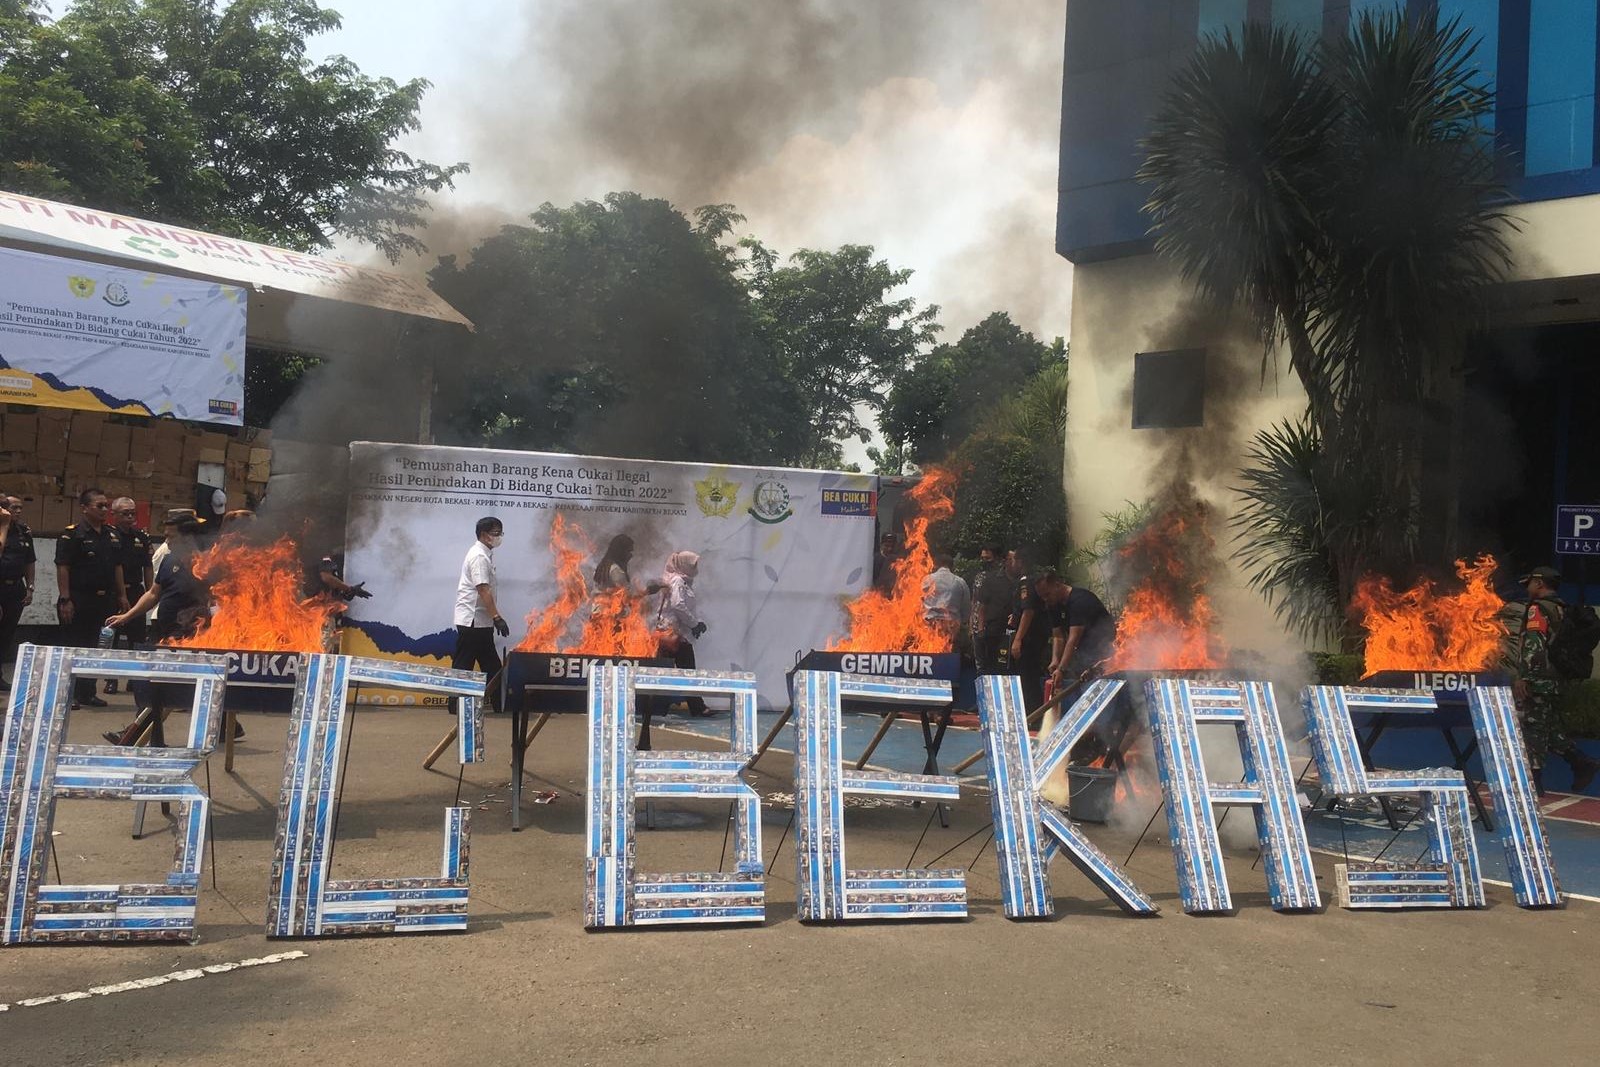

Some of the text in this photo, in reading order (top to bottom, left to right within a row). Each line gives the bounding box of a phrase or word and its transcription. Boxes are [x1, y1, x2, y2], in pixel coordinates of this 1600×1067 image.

[64, 208, 253, 258] MANDIRI
[260, 248, 415, 291] LESTARI
[0, 311, 13, 322] sil
[15, 313, 72, 330] Penindakan
[75, 322, 85, 332] Di
[88, 323, 120, 338] Bidang
[121, 328, 147, 340] Cukai
[148, 331, 176, 345] Tahun
[76, 311, 109, 326] Barang
[111, 316, 133, 328] Kena
[135, 320, 160, 332] Cukai
[162, 324, 185, 336] Ilegal
[369, 472, 403, 486] Hasil
[408, 475, 486, 490] Penindakan
[491, 478, 504, 491] Di
[508, 480, 553, 497] Bidang
[556, 483, 592, 495] Cukai
[596, 485, 635, 498] Tahun
[493, 463, 538, 480] Barang
[542, 466, 573, 480] Kena
[578, 468, 612, 482] Cukai
[617, 470, 651, 486] Ilegal
[395, 495, 422, 503] NEGERI
[424, 496, 443, 504] KOTA
[476, 499, 498, 507] KPPBC
[500, 500, 515, 508] TMP
[524, 501, 548, 510] BEKASI
[824, 491, 869, 504] BEA CUKAI
[1574, 515, 1593, 537] P
[227, 652, 300, 678] CUKA
[841, 654, 933, 676] GEMPUR
[585, 664, 1563, 929] BEKASI
